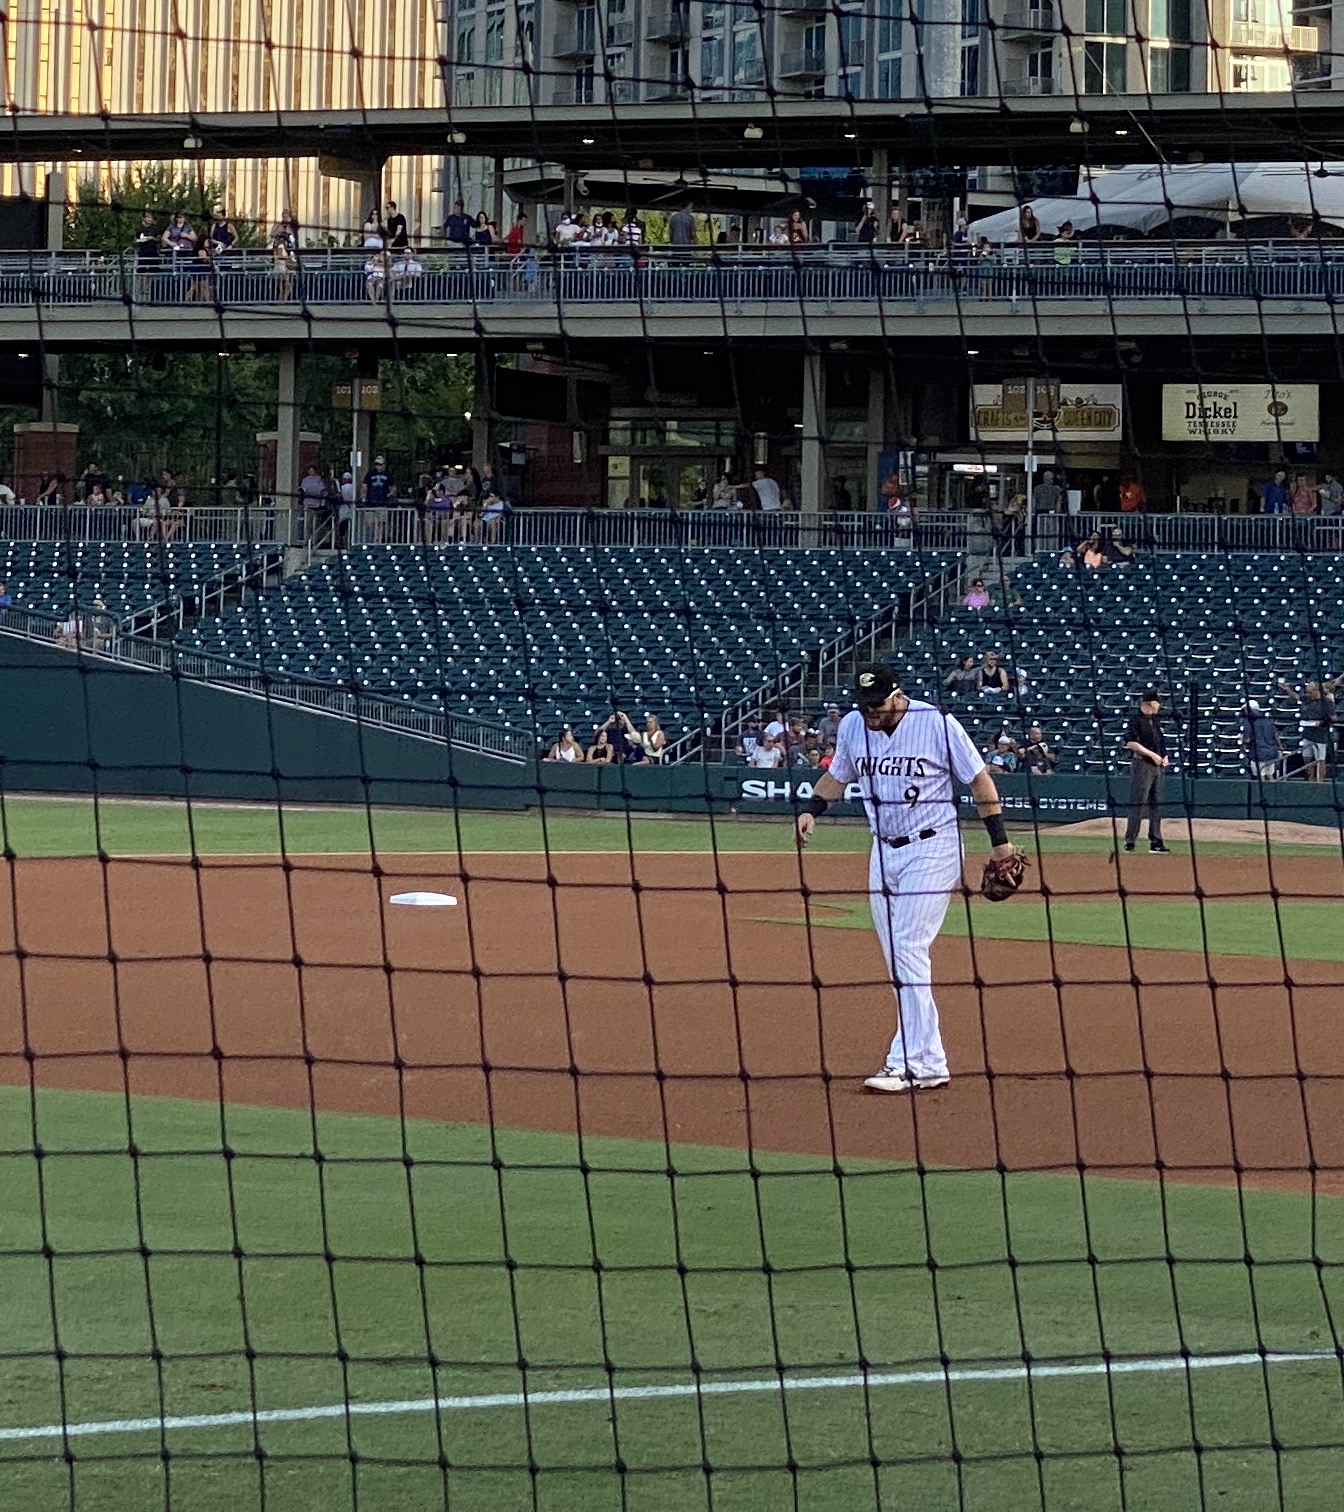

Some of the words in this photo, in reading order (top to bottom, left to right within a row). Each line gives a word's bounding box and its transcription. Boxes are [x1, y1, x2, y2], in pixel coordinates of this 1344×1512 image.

[1185, 401, 1238, 419] Dickel
[856, 756, 927, 778] KNIGHTS
[741, 779, 867, 802] SHAP
[904, 785, 920, 809] 9
